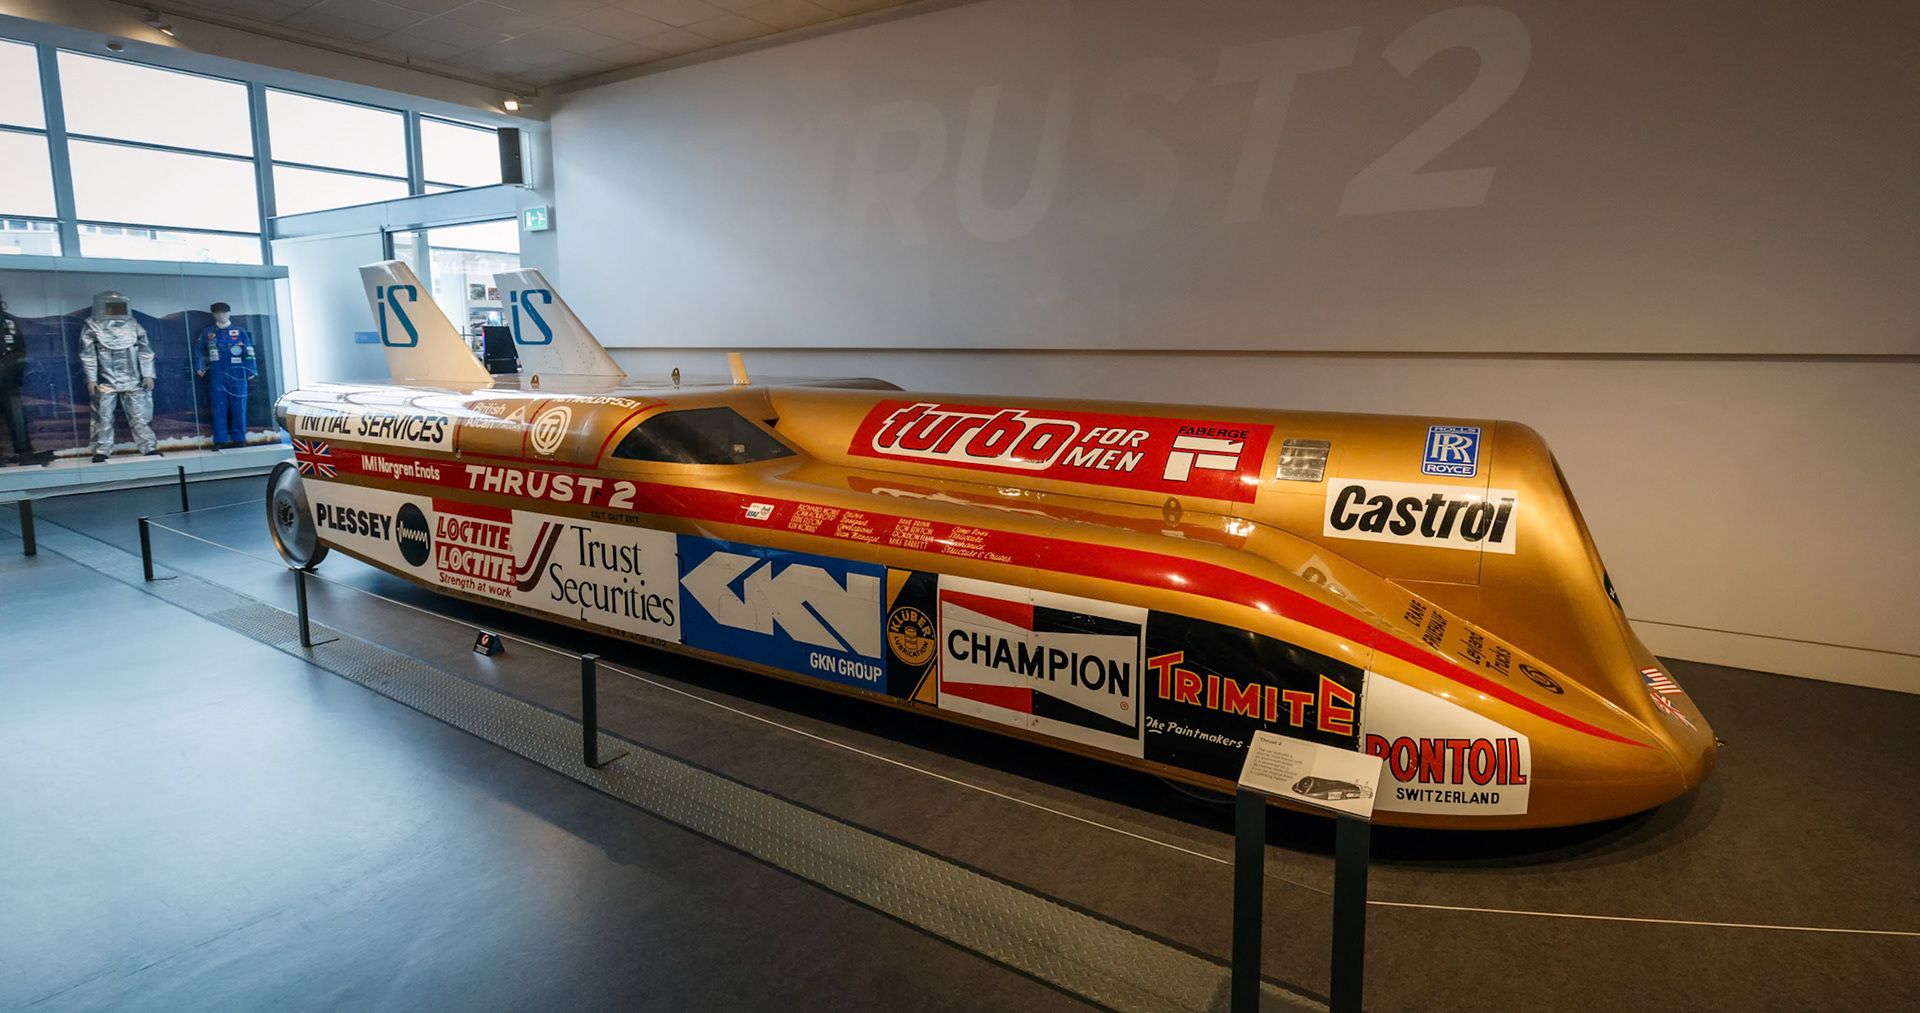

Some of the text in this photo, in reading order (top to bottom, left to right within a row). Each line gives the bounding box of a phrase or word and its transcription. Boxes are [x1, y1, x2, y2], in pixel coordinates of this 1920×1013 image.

[1339, 4, 1532, 216] 2
[472, 402, 506, 416] British
[300, 409, 448, 443] INITIAL SERVICES
[877, 403, 1077, 466] turbo
[1080, 427, 1150, 448] FOR
[1178, 426, 1250, 439] FABERGE
[1434, 426, 1476, 434] ROLLS
[362, 455, 440, 481] IMI Norgren Enots
[1061, 446, 1145, 472] MEN
[1427, 464, 1472, 474] ROYCE
[465, 464, 637, 509] THRUST 2
[316, 502, 392, 541] PLESSEY
[591, 510, 605, 520] CUT
[608, 513, 623, 522] OUT
[1330, 485, 1515, 543] Castrol
[436, 515, 511, 551] LOCTITE
[438, 547, 515, 582] LOCTITE
[570, 525, 642, 576] Trust
[439, 572, 512, 599] Strength at work
[550, 562, 675, 627] Securities
[890, 608, 932, 638] KLÜBER
[1404, 599, 1427, 628] CRANE
[893, 635, 929, 658] LUBRICATION
[1457, 627, 1486, 666] Leyland
[1486, 645, 1512, 677] Trucks
[810, 652, 883, 683] GKN GROUP
[947, 629, 1130, 698] CHAMPION
[1148, 650, 1356, 737] TRIMITE
[1146, 716, 1244, 749] The Paintmakers
[1365, 733, 1528, 785] PONTOIL
[1396, 787, 1500, 805] SWITZERLAND
